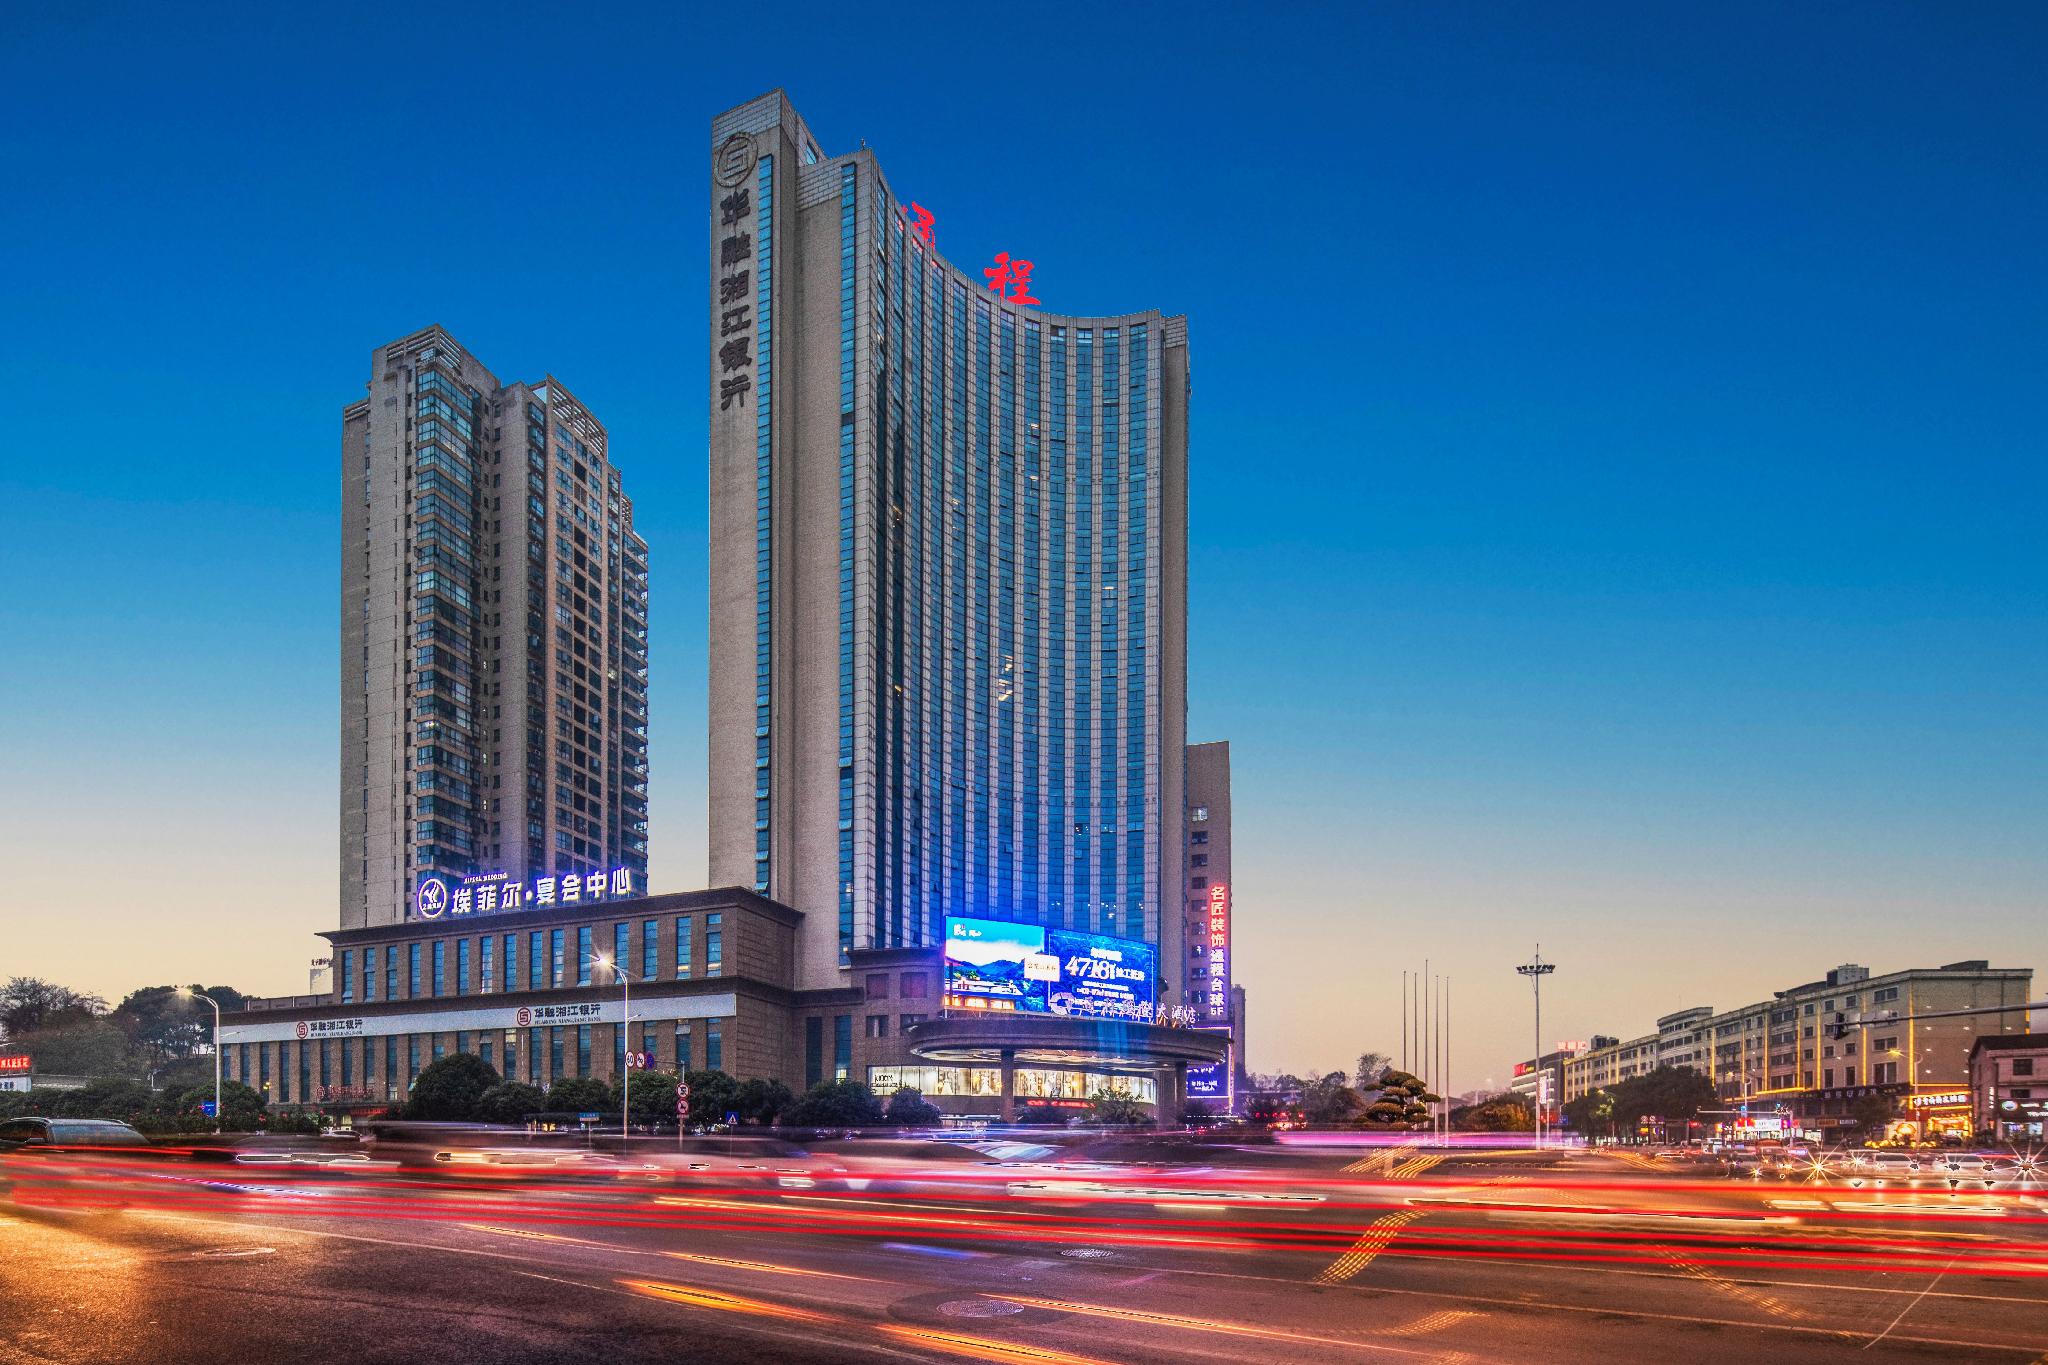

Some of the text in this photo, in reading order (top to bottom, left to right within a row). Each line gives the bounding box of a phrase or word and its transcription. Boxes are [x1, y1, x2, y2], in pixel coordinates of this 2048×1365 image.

[719, 188, 752, 411] 华融湘江银行
[1210, 886, 1225, 948] 名匠装饰
[310, 1019, 363, 1032] 华融湘江银行
[534, 1003, 601, 1018] 华融湘江银行
